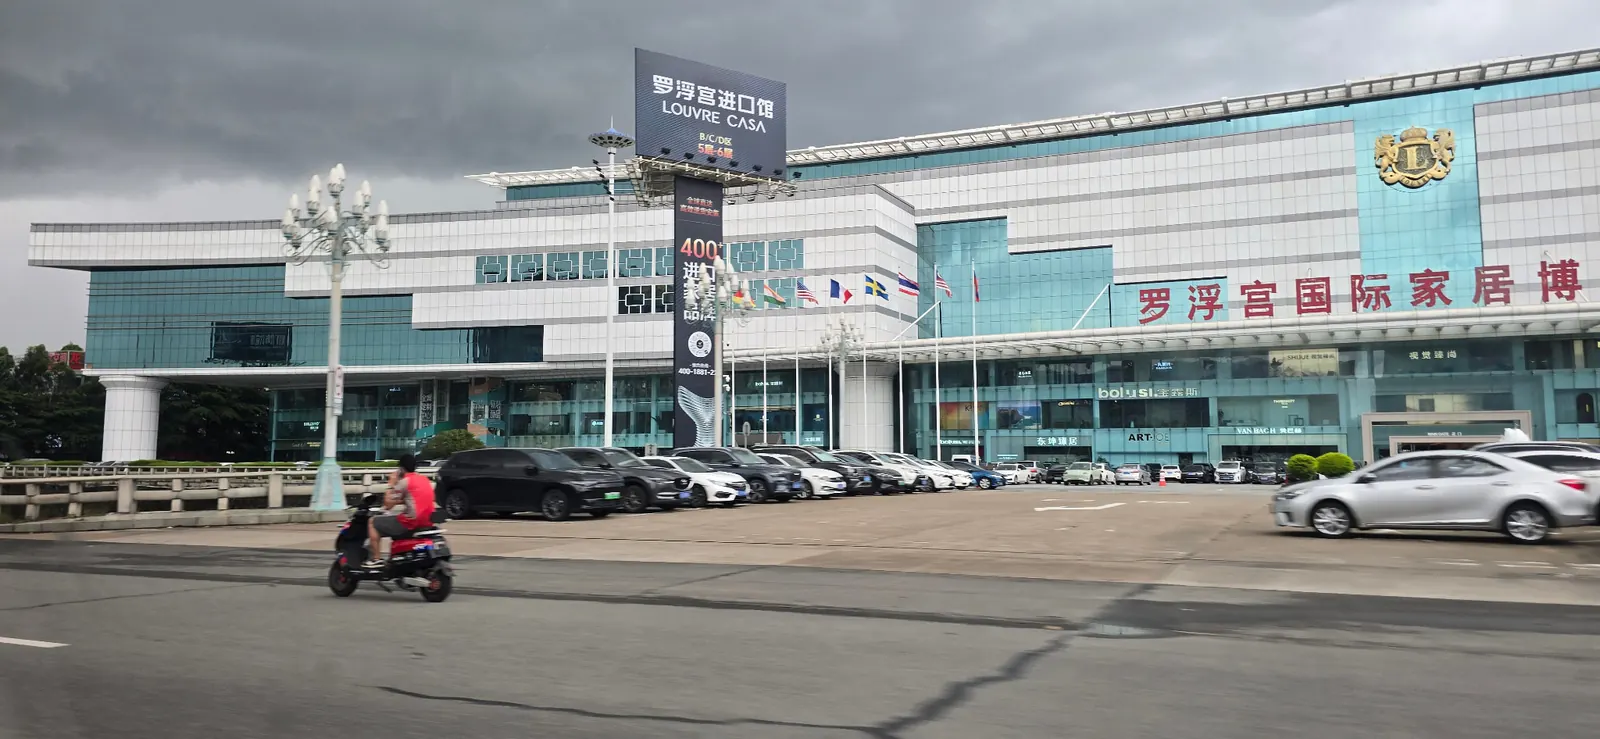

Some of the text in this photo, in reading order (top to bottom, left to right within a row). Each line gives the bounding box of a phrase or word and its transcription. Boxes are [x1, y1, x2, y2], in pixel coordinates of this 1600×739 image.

[652, 74, 774, 119] 罗浮宫进口馆
[662, 100, 767, 133] LOUVRE CASA
[1138, 258, 1583, 325] 罗浮宫国际家居博
